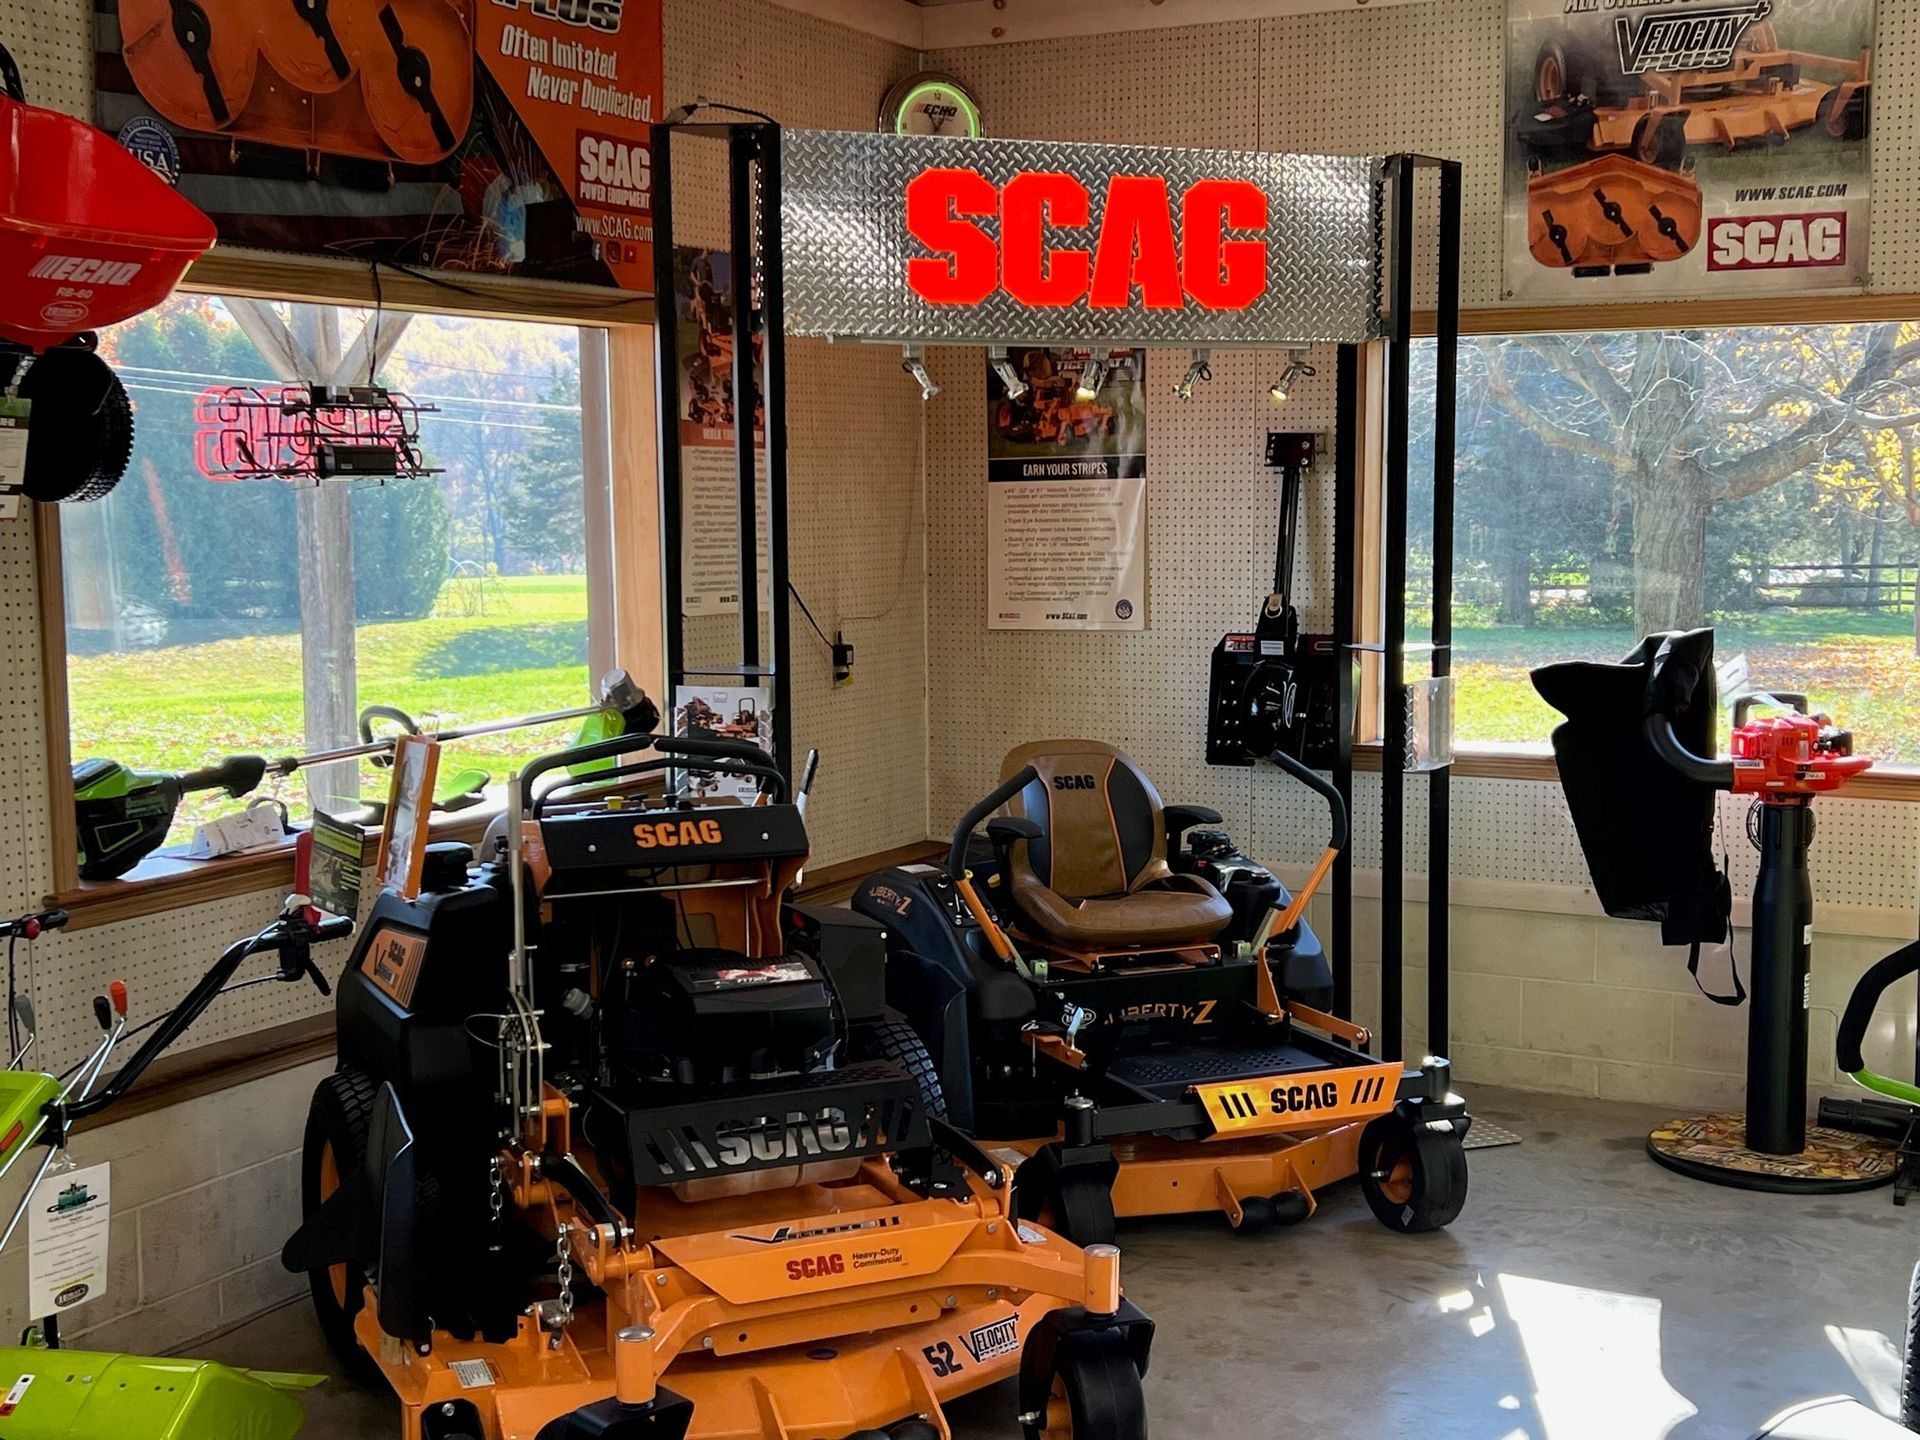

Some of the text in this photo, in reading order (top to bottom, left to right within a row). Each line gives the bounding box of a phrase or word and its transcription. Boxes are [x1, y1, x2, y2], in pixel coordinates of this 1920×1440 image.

[501, 24, 618, 80] Often Imitated.
[1616, 4, 1770, 75] VELOCITY
[1637, 50, 1733, 73] PLUS
[527, 66, 654, 123] Never Duplicated.
[923, 104, 958, 117] ECHO
[580, 136, 651, 191] SCAG
[580, 182, 651, 209] POWER EQUIPMENT
[1735, 184, 1848, 202] WWW.SCAG.COM
[576, 214, 653, 242] www.SCAG.com
[906, 167, 1268, 310] SCAG
[1712, 217, 1842, 265] SCAG
[50, 256, 142, 286] ECHO
[1023, 462, 1108, 477] EARN YOUR STRIPES
[1053, 775, 1096, 790] SCAG
[633, 819, 722, 848] SCAG
[896, 896, 912, 916] Z
[1193, 1000, 1217, 1025] Z
[1270, 1082, 1338, 1114] SCAG
[715, 1106, 851, 1165] SCAG
[786, 1247, 900, 1281] SCAG Heavy-Duty
[853, 1255, 902, 1269] Commercial
[921, 1312, 1020, 1377] 52 VELOCITY
